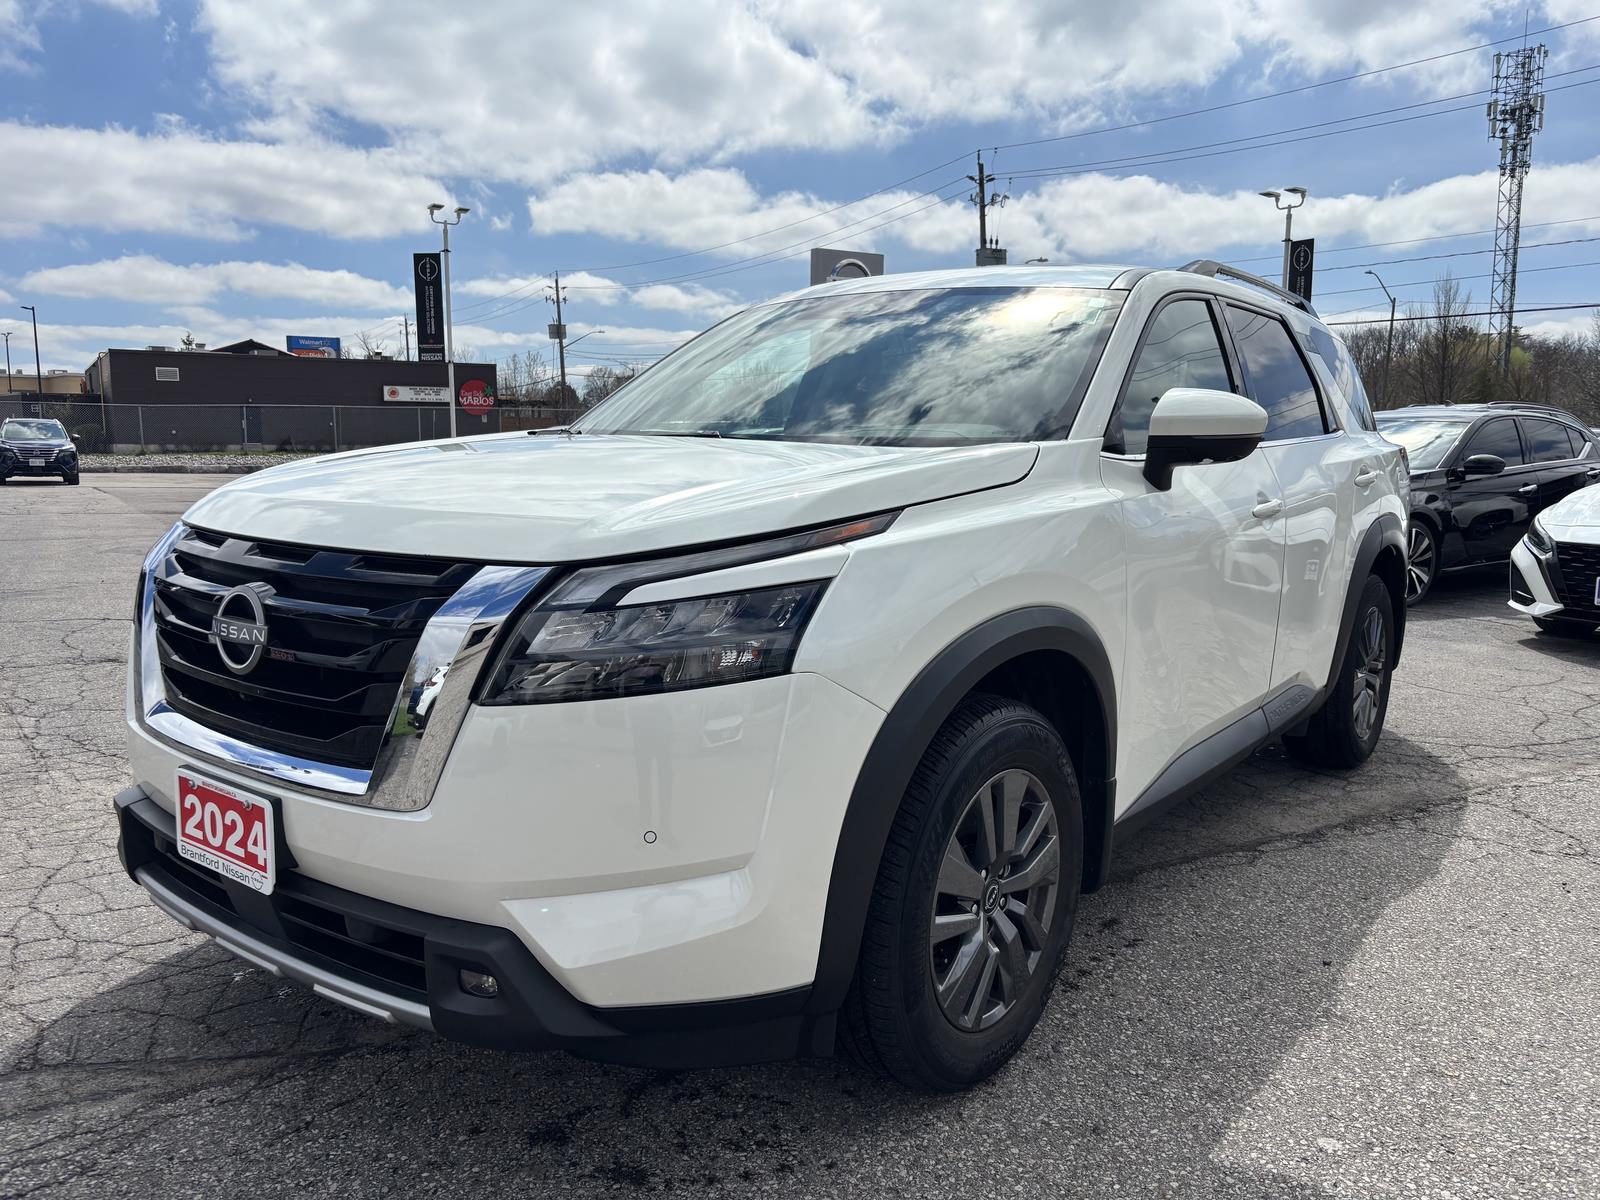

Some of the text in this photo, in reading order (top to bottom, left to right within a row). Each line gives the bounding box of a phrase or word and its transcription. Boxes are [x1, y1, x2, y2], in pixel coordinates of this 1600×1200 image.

[298, 338, 323, 346] Walmart
[212, 617, 265, 642] NISSAN
[184, 793, 268, 867] 2024
[180, 844, 251, 884] Brantford Nissan
